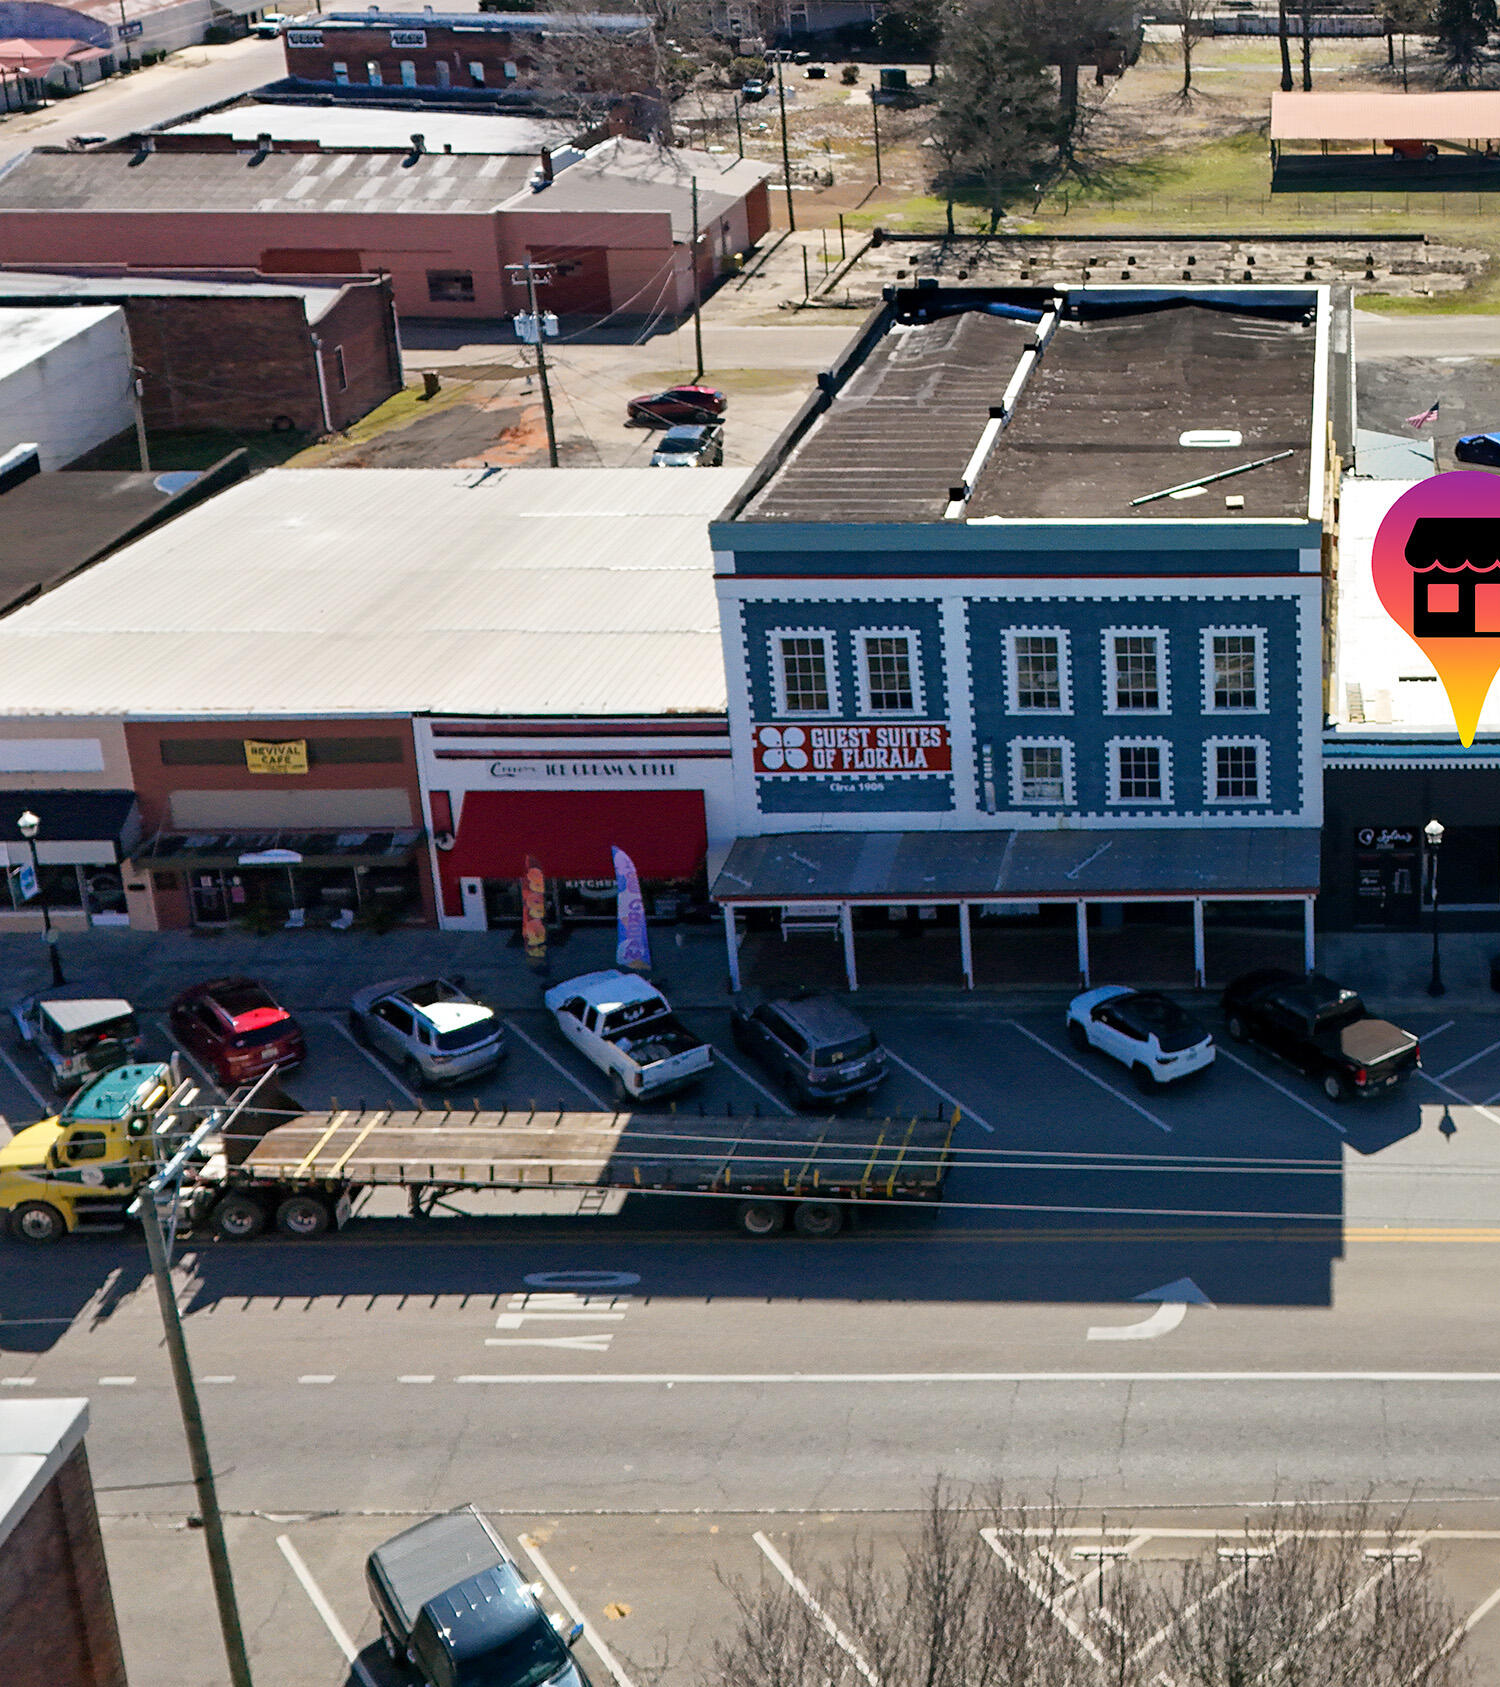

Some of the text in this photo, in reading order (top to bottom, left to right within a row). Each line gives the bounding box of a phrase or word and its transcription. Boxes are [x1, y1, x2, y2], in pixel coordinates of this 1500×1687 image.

[810, 727, 942, 748] GUEST SUITES
[250, 745, 301, 755] REVIVAL
[813, 748, 929, 770] OF FLORALA
[829, 782, 856, 793] Circa
